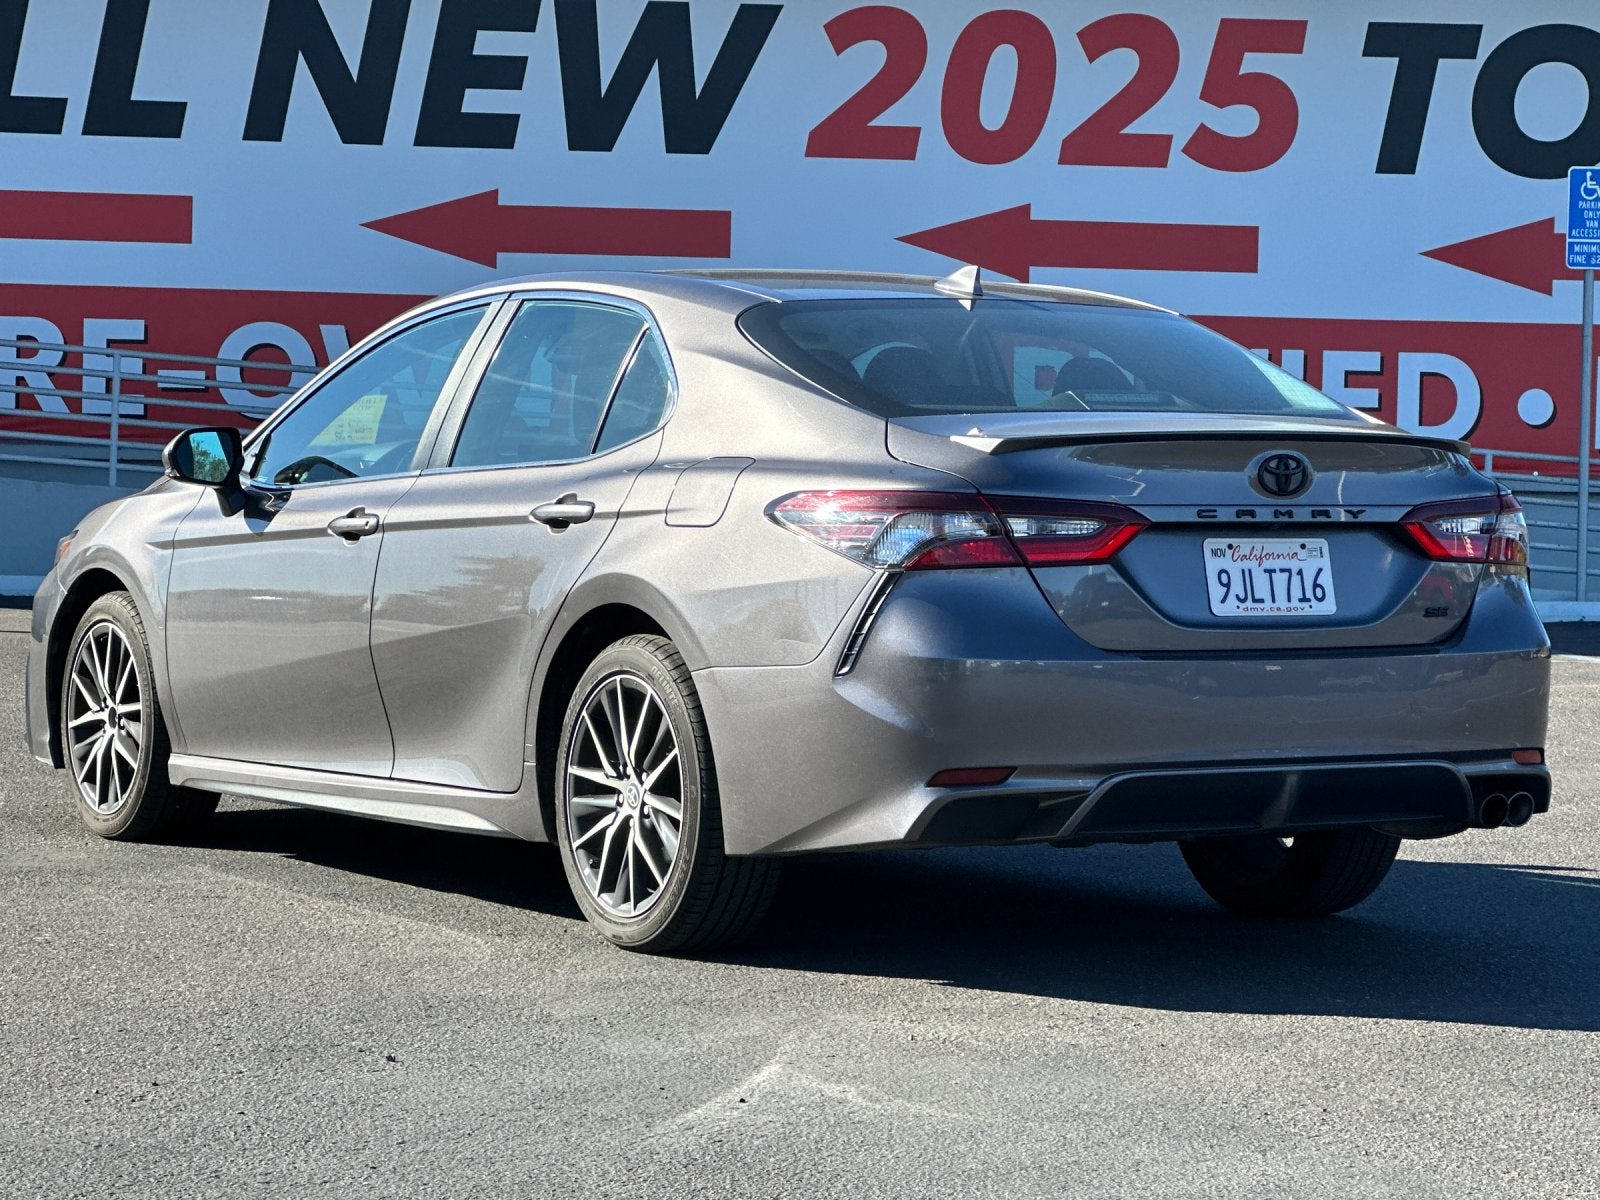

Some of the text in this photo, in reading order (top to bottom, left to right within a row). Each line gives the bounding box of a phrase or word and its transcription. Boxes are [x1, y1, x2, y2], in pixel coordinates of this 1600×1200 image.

[242, 0, 784, 155] NEW
[804, 5, 1308, 173] 2025
[1361, 21, 1600, 180] TO
[1585, 219, 1599, 228] VAN
[1569, 254, 1587, 264] FINE
[1196, 508, 1367, 519] CAMRY
[1211, 547, 1226, 558] NOV
[1231, 544, 1308, 567] California
[1217, 567, 1327, 604] 9JLT716
[1242, 605, 1306, 613] dmv.ca.gov
